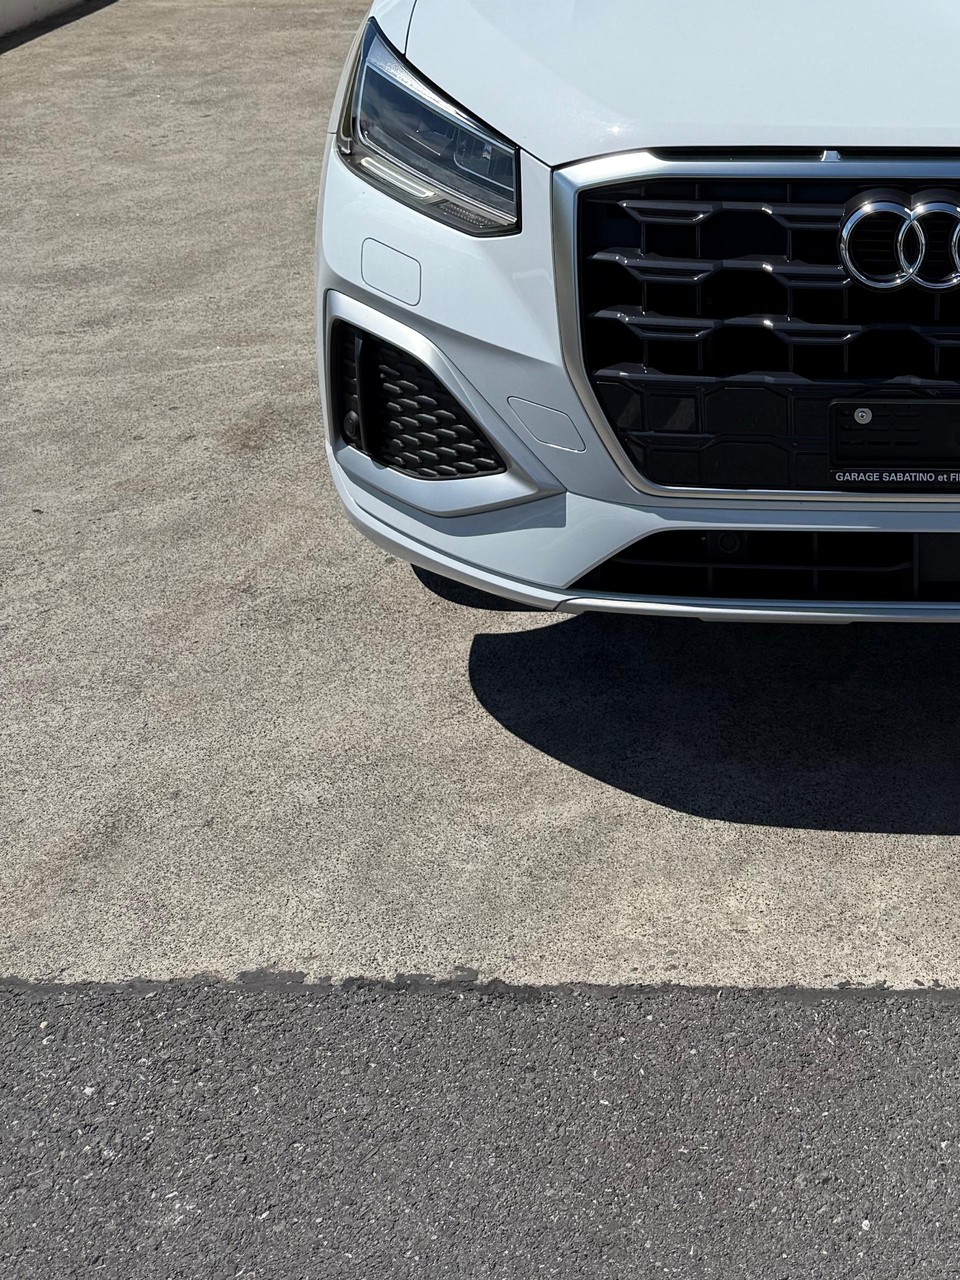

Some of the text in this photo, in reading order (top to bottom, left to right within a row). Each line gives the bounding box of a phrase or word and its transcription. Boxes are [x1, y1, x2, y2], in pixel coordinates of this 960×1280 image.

[835, 472, 880, 482] GARAGE
[882, 472, 935, 482] SABATINO
[937, 474, 948, 482] et
